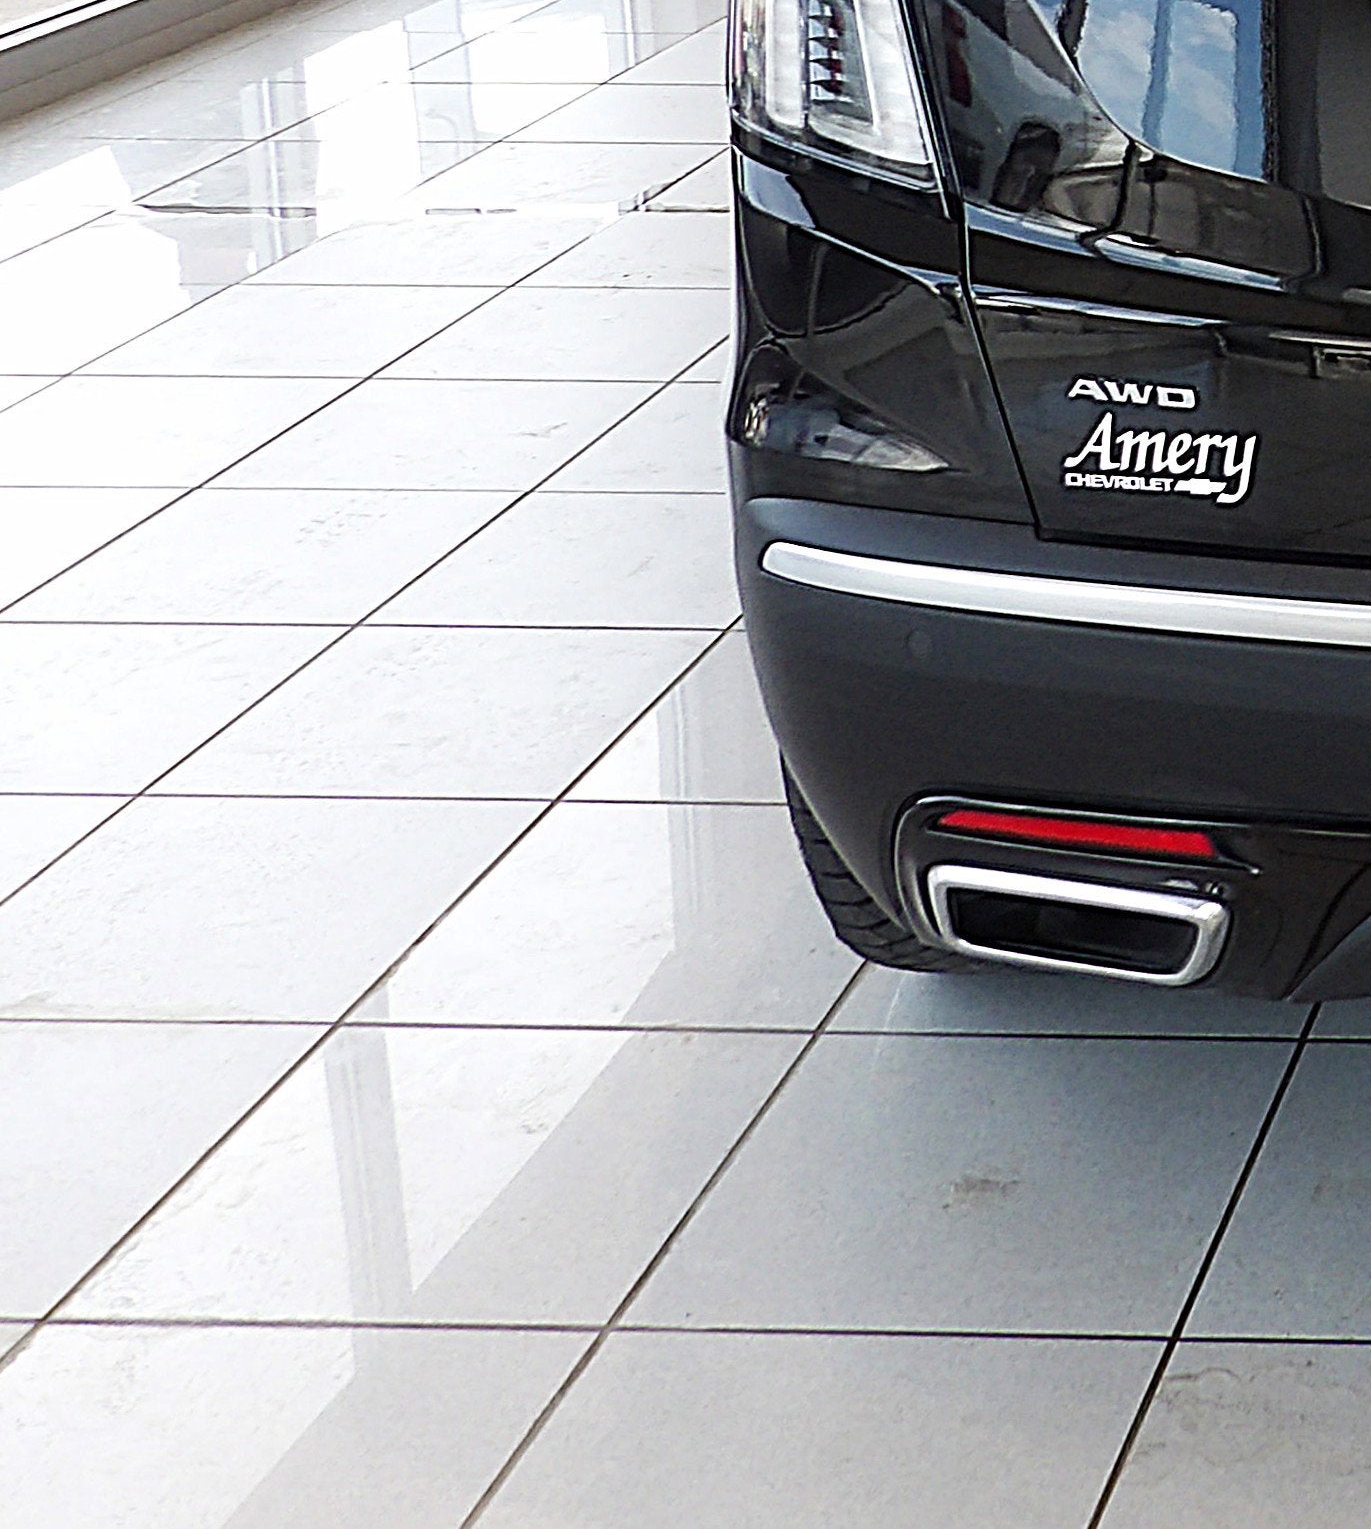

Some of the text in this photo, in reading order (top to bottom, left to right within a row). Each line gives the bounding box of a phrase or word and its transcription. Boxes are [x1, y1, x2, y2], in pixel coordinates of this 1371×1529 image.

[1068, 378, 1196, 409] AWD
[1064, 412, 1257, 503] Amery
[1064, 472, 1174, 492] CHEVROLET
